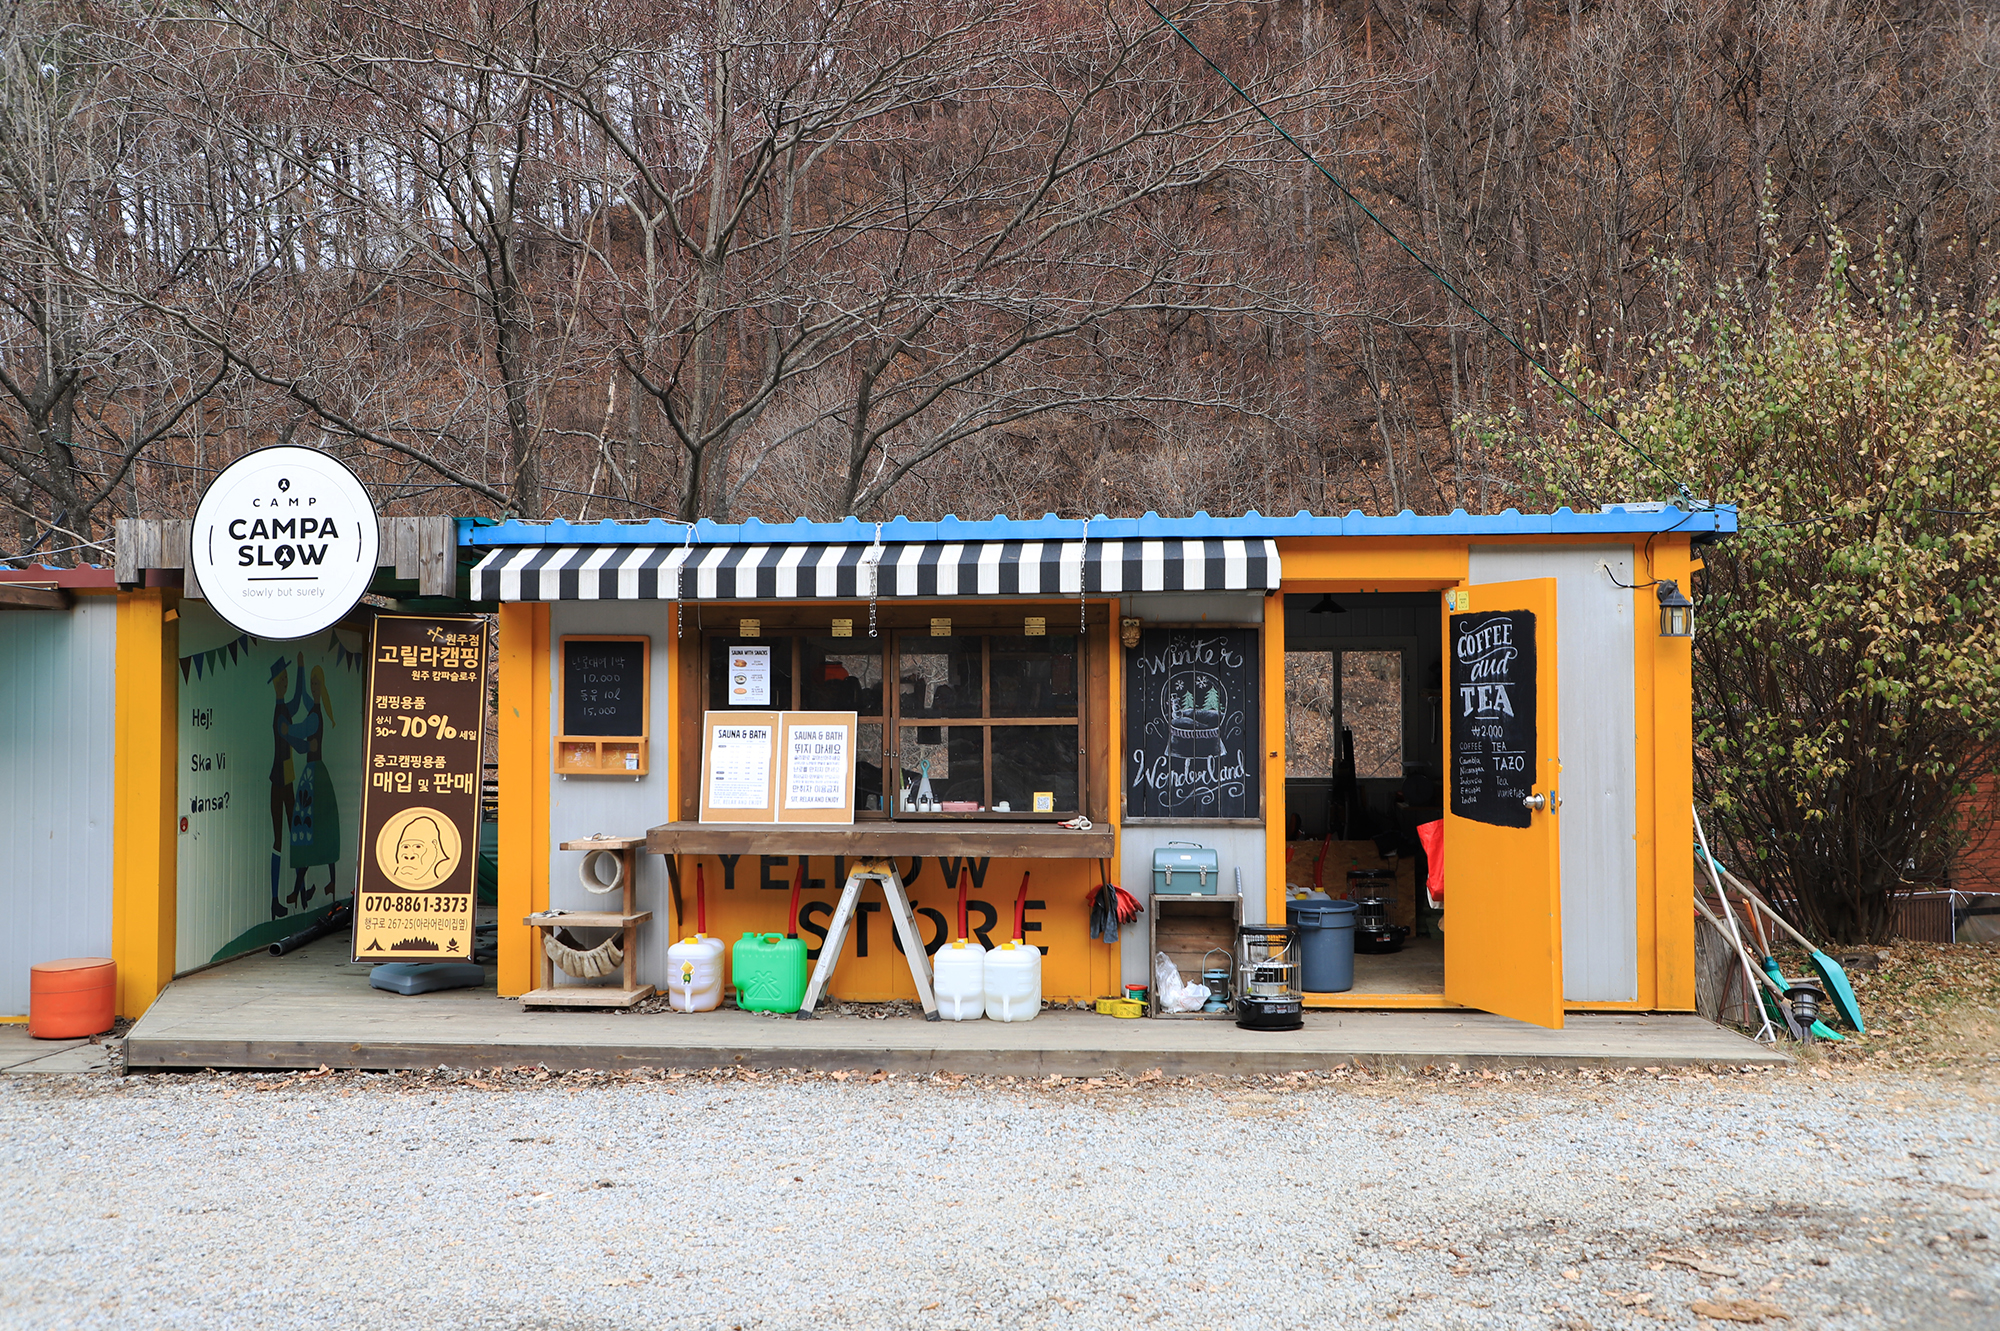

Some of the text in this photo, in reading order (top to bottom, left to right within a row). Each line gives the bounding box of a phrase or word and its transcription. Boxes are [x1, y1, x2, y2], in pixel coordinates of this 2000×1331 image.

[252, 497, 317, 507] CAMP
[228, 517, 339, 541] CAMPA
[238, 544, 329, 570] SLOW
[242, 586, 325, 598] slowly but surely
[445, 634, 479, 646] 원주점
[1457, 624, 1513, 658] COFFEE
[378, 645, 479, 668] 고릴라캠핑
[1136, 637, 1244, 676] Winter
[1470, 650, 1513, 682] and
[411, 670, 430, 680] 원주
[375, 695, 427, 710] 캠핑용품
[1460, 684, 1515, 717] TEA
[192, 708, 213, 730] Hej!
[375, 715, 392, 725] 상시
[375, 714, 477, 741] 30~ 70% 세일
[718, 729, 767, 739] SAUNA & BATH
[794, 731, 843, 741] SAUNA & BATH
[794, 743, 841, 754] 뛰지 마세요
[1459, 741, 1482, 751] COFFEE
[1491, 741, 1507, 752] TEA
[191, 752, 226, 772] Ska Vi
[373, 754, 447, 769] 중고캠핑용품
[1132, 748, 1251, 790] Wonderland
[1492, 755, 1525, 772] TAZO
[373, 771, 474, 795] 매입 및 판매
[1496, 775, 1509, 786] Tea
[190, 791, 230, 814] dansa?
[365, 896, 468, 913] 070-8861-3373
